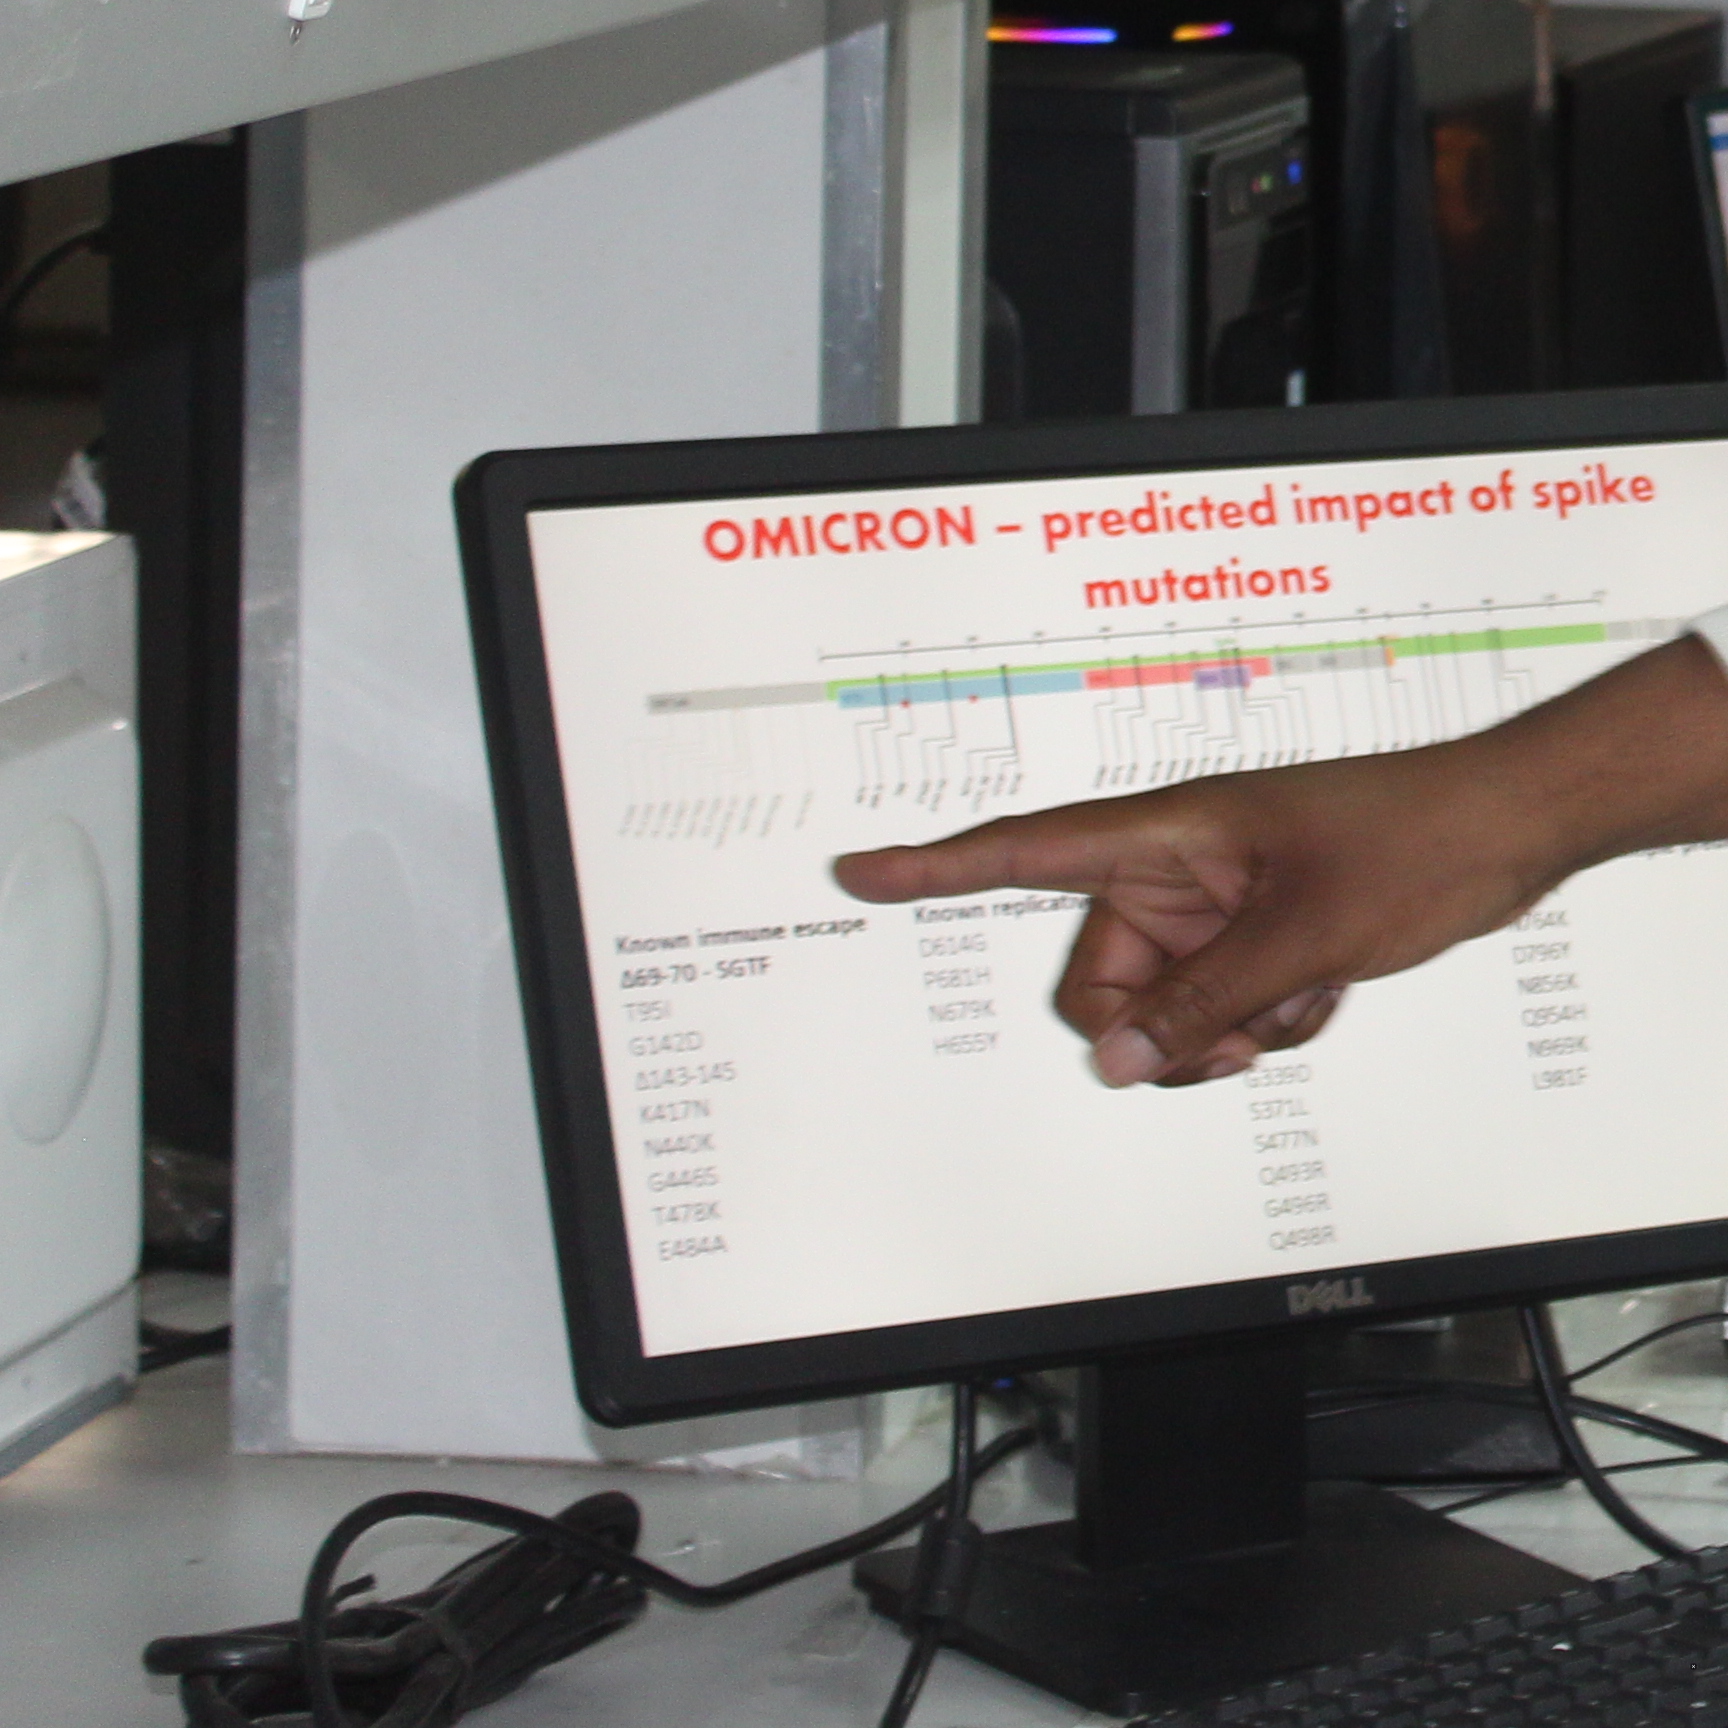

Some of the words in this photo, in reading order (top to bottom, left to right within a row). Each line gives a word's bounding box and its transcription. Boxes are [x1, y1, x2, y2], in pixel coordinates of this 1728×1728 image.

[701, 505, 978, 562] OMICRON
[1041, 484, 1278, 553] predicted
[1293, 479, 1455, 534] impact
[1468, 469, 1517, 512] of
[1532, 464, 1656, 520] spike
[1083, 557, 1332, 609] mutations
[914, 904, 986, 924] Known
[616, 935, 690, 954] Known
[699, 928, 786, 946] immune
[794, 918, 866, 937] escape
[1287, 1276, 1374, 1316] DELL
